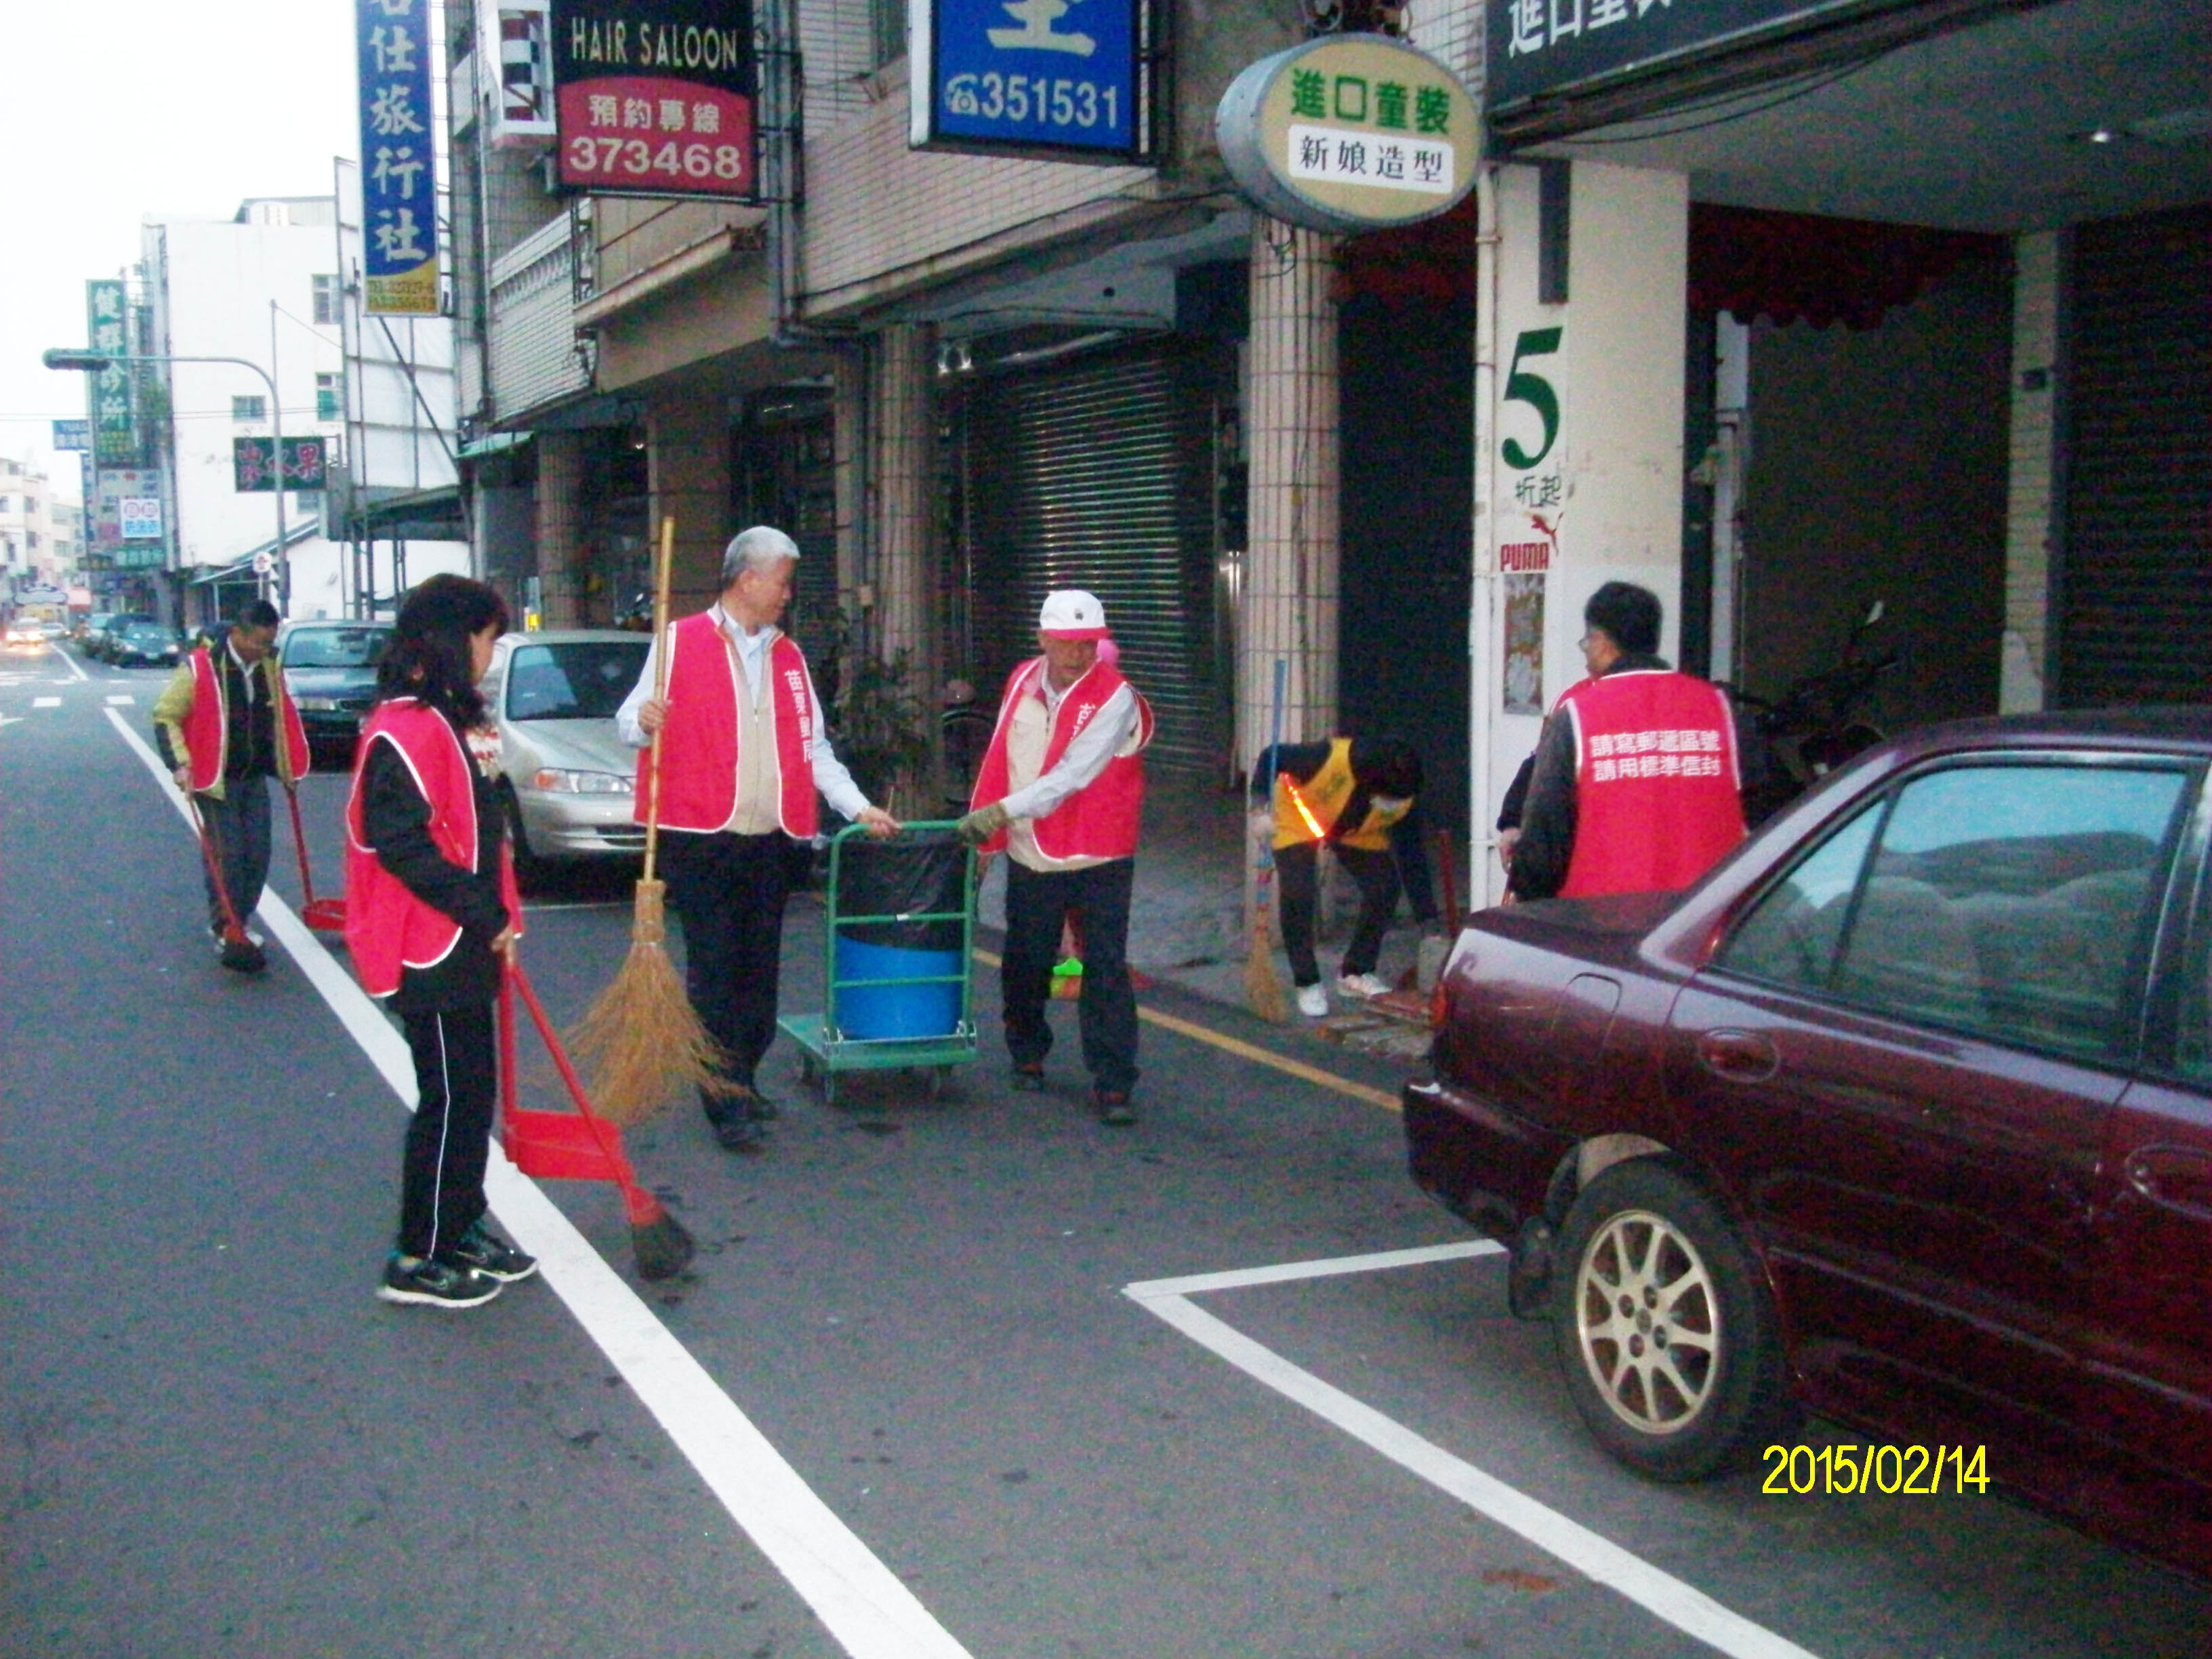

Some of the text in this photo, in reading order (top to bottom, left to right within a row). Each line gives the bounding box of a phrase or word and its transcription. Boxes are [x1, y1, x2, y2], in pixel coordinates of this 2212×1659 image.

[572, 17, 737, 70] HAIR SALOON
[1509, 0, 1672, 58] 進口
[589, 95, 720, 134] 預約專線
[981, 73, 1117, 128] 351531
[1291, 68, 1451, 135] 進口童裝
[570, 137, 743, 179] 373468
[1300, 136, 1443, 183] 新娘造型
[1501, 327, 1563, 470] 5
[1500, 543, 1550, 571] PUMA
[1589, 729, 1722, 758] 請寫郵遞區號
[1593, 754, 1721, 782] 請用標準信封
